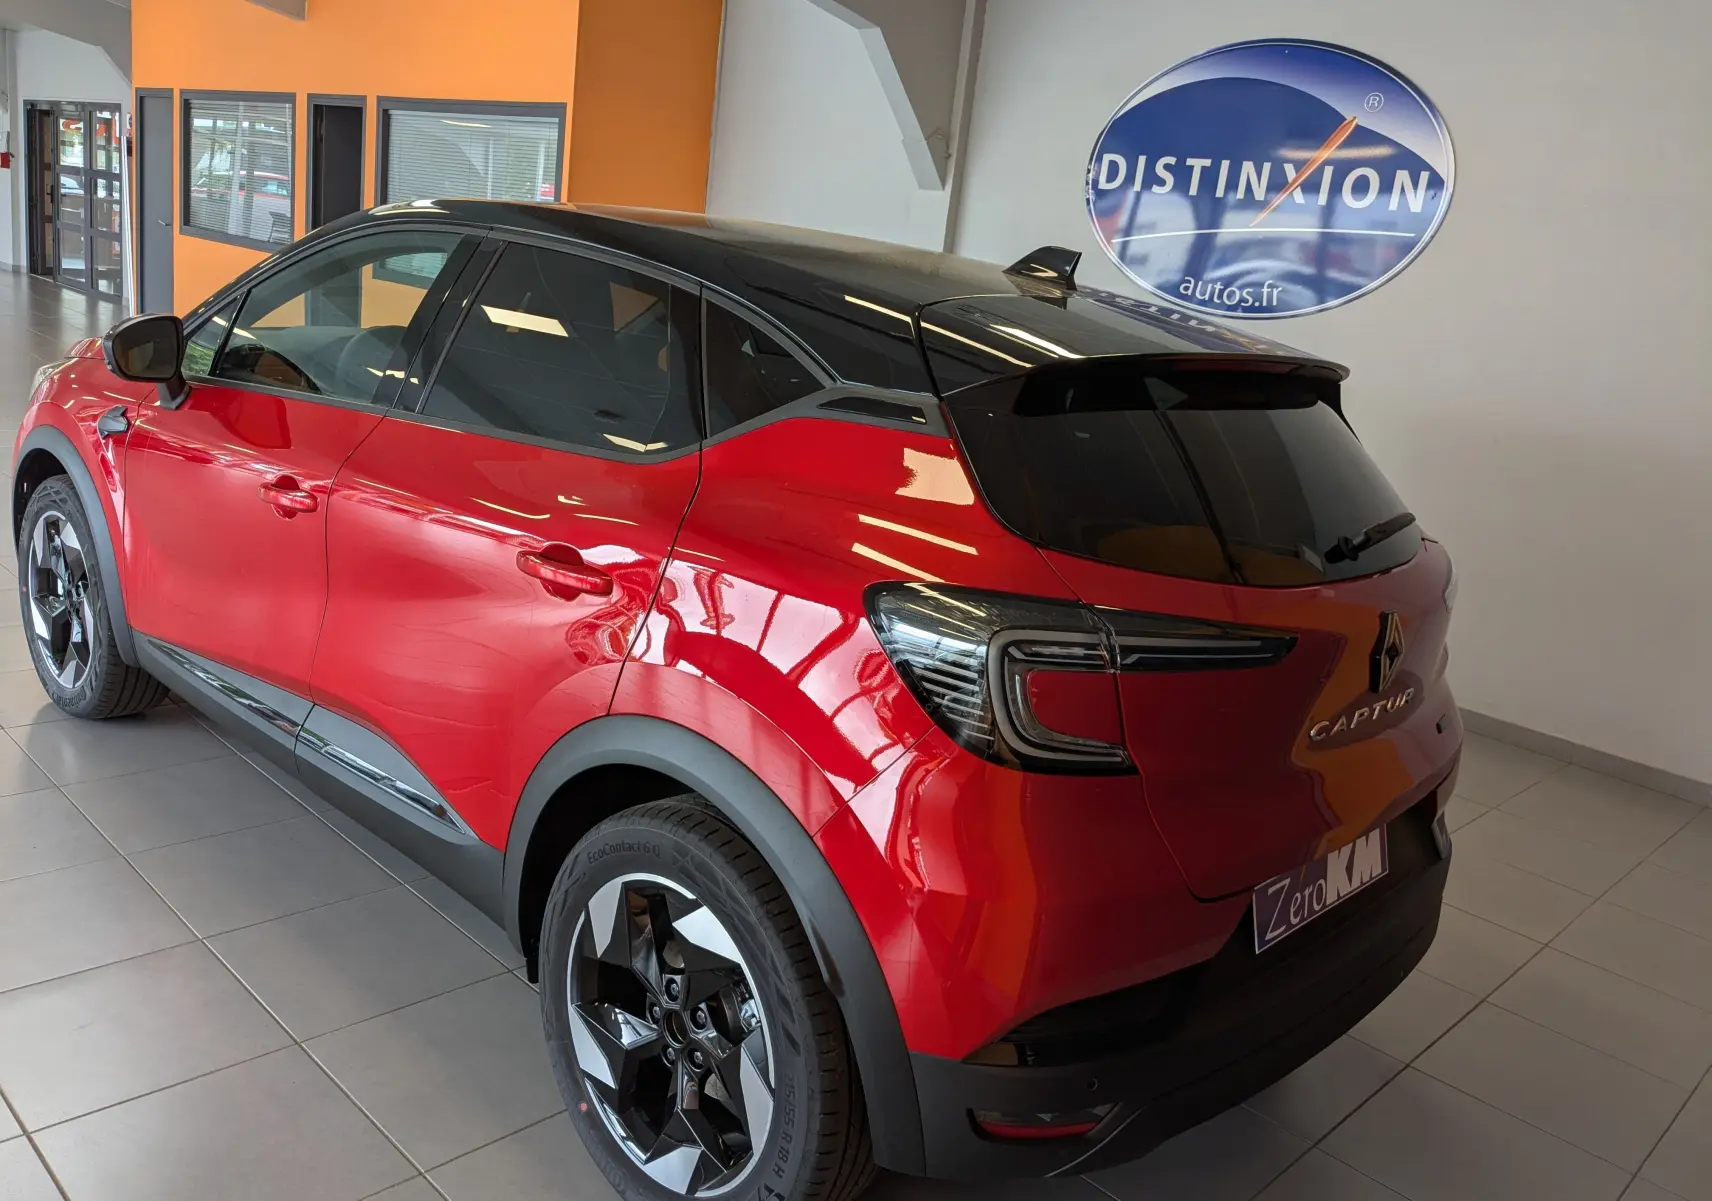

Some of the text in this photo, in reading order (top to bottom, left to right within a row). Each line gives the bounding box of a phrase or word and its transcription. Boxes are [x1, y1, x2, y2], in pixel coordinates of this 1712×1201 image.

[1097, 152, 1431, 213] DISTINXION
[1179, 275, 1283, 307] autos.fr
[1310, 687, 1414, 741] CAPTUR
[587, 840, 641, 865] EcoContact
[644, 842, 651, 854] 6
[772, 1072, 796, 1179] 215/55 R 18 H
